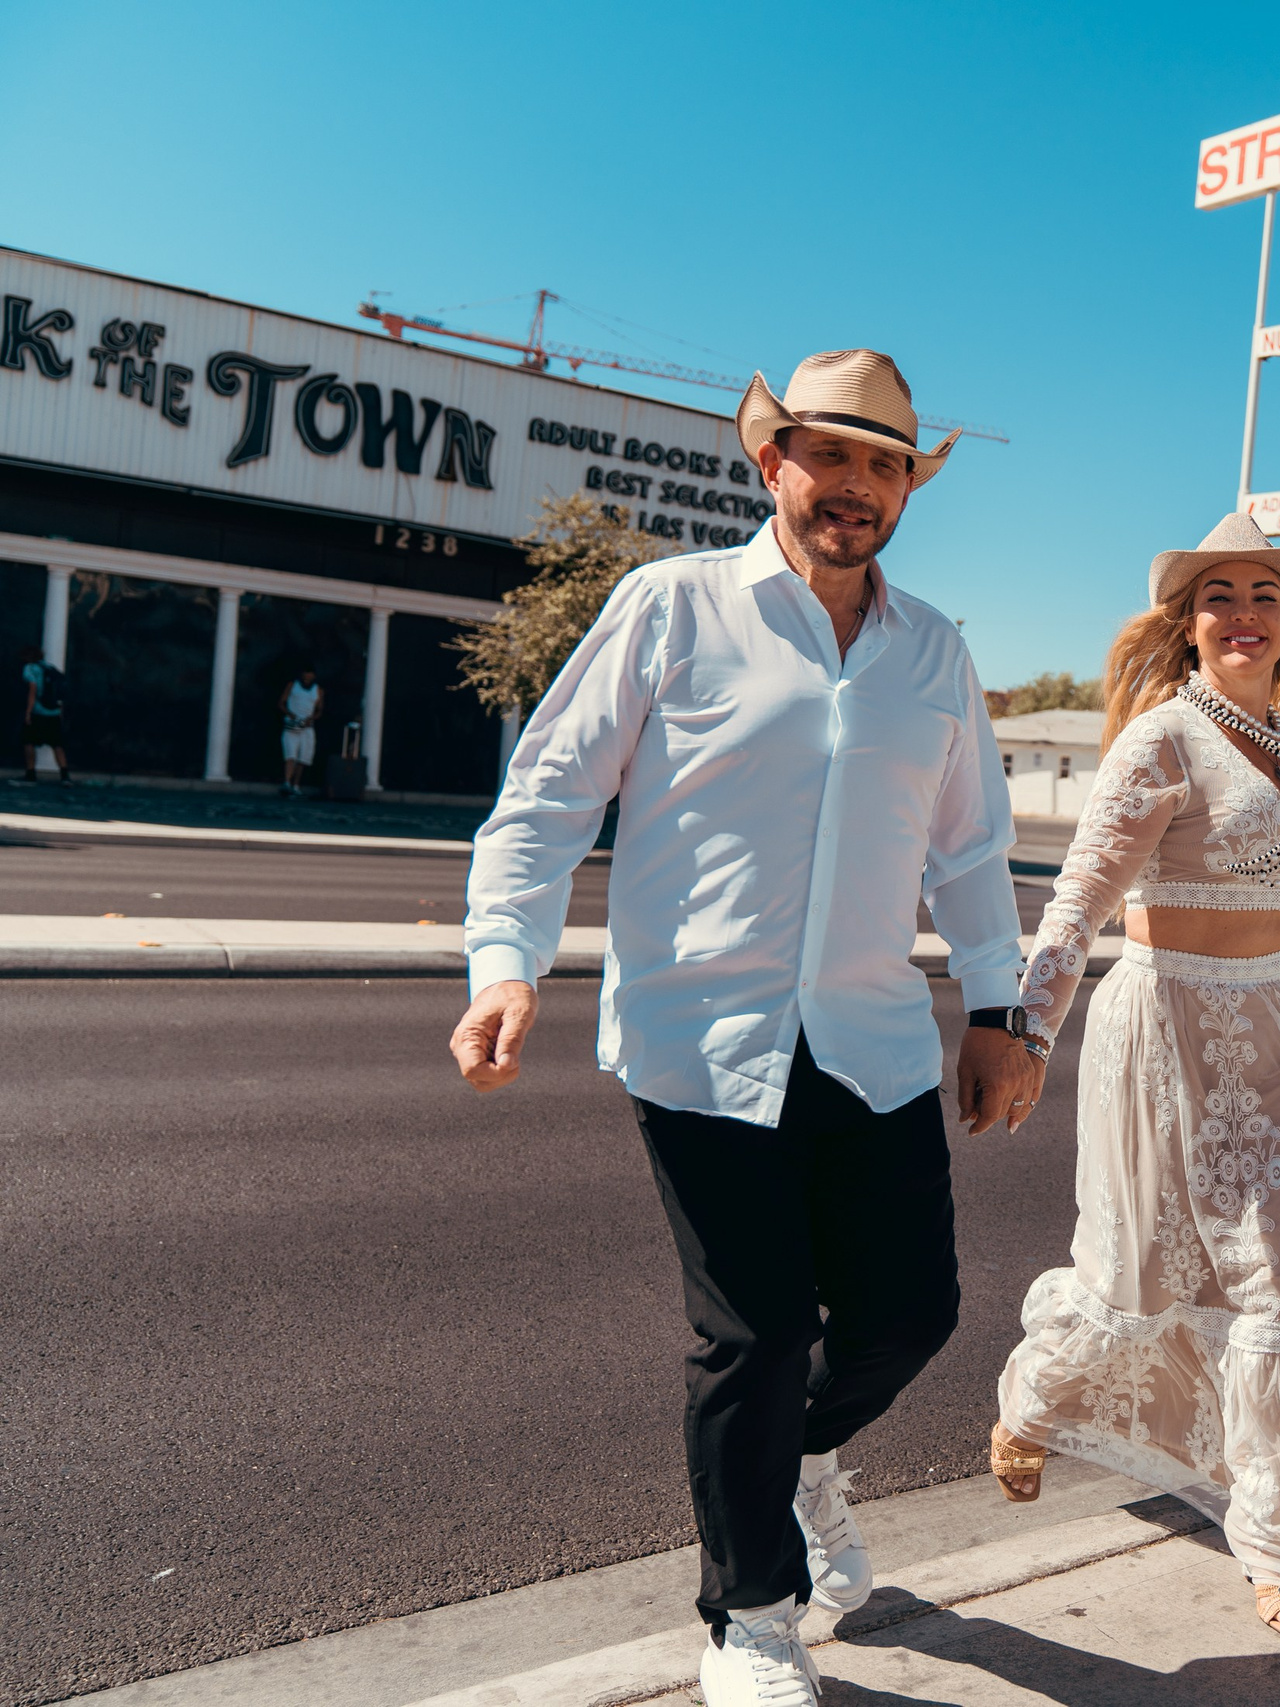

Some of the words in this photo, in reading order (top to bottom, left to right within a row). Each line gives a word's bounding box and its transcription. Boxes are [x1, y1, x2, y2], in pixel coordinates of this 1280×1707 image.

[101, 317, 165, 357] OF
[89, 348, 193, 427] THE
[207, 351, 496, 490] TOWN
[528, 417, 618, 456] ADULT
[623, 437, 721, 478] BOOKS
[729, 460, 750, 486] &
[585, 465, 653, 499] BEST
[660, 480, 777, 522] SELECTIO
[374, 524, 458, 556] 1238
[639, 511, 684, 540] LAS
